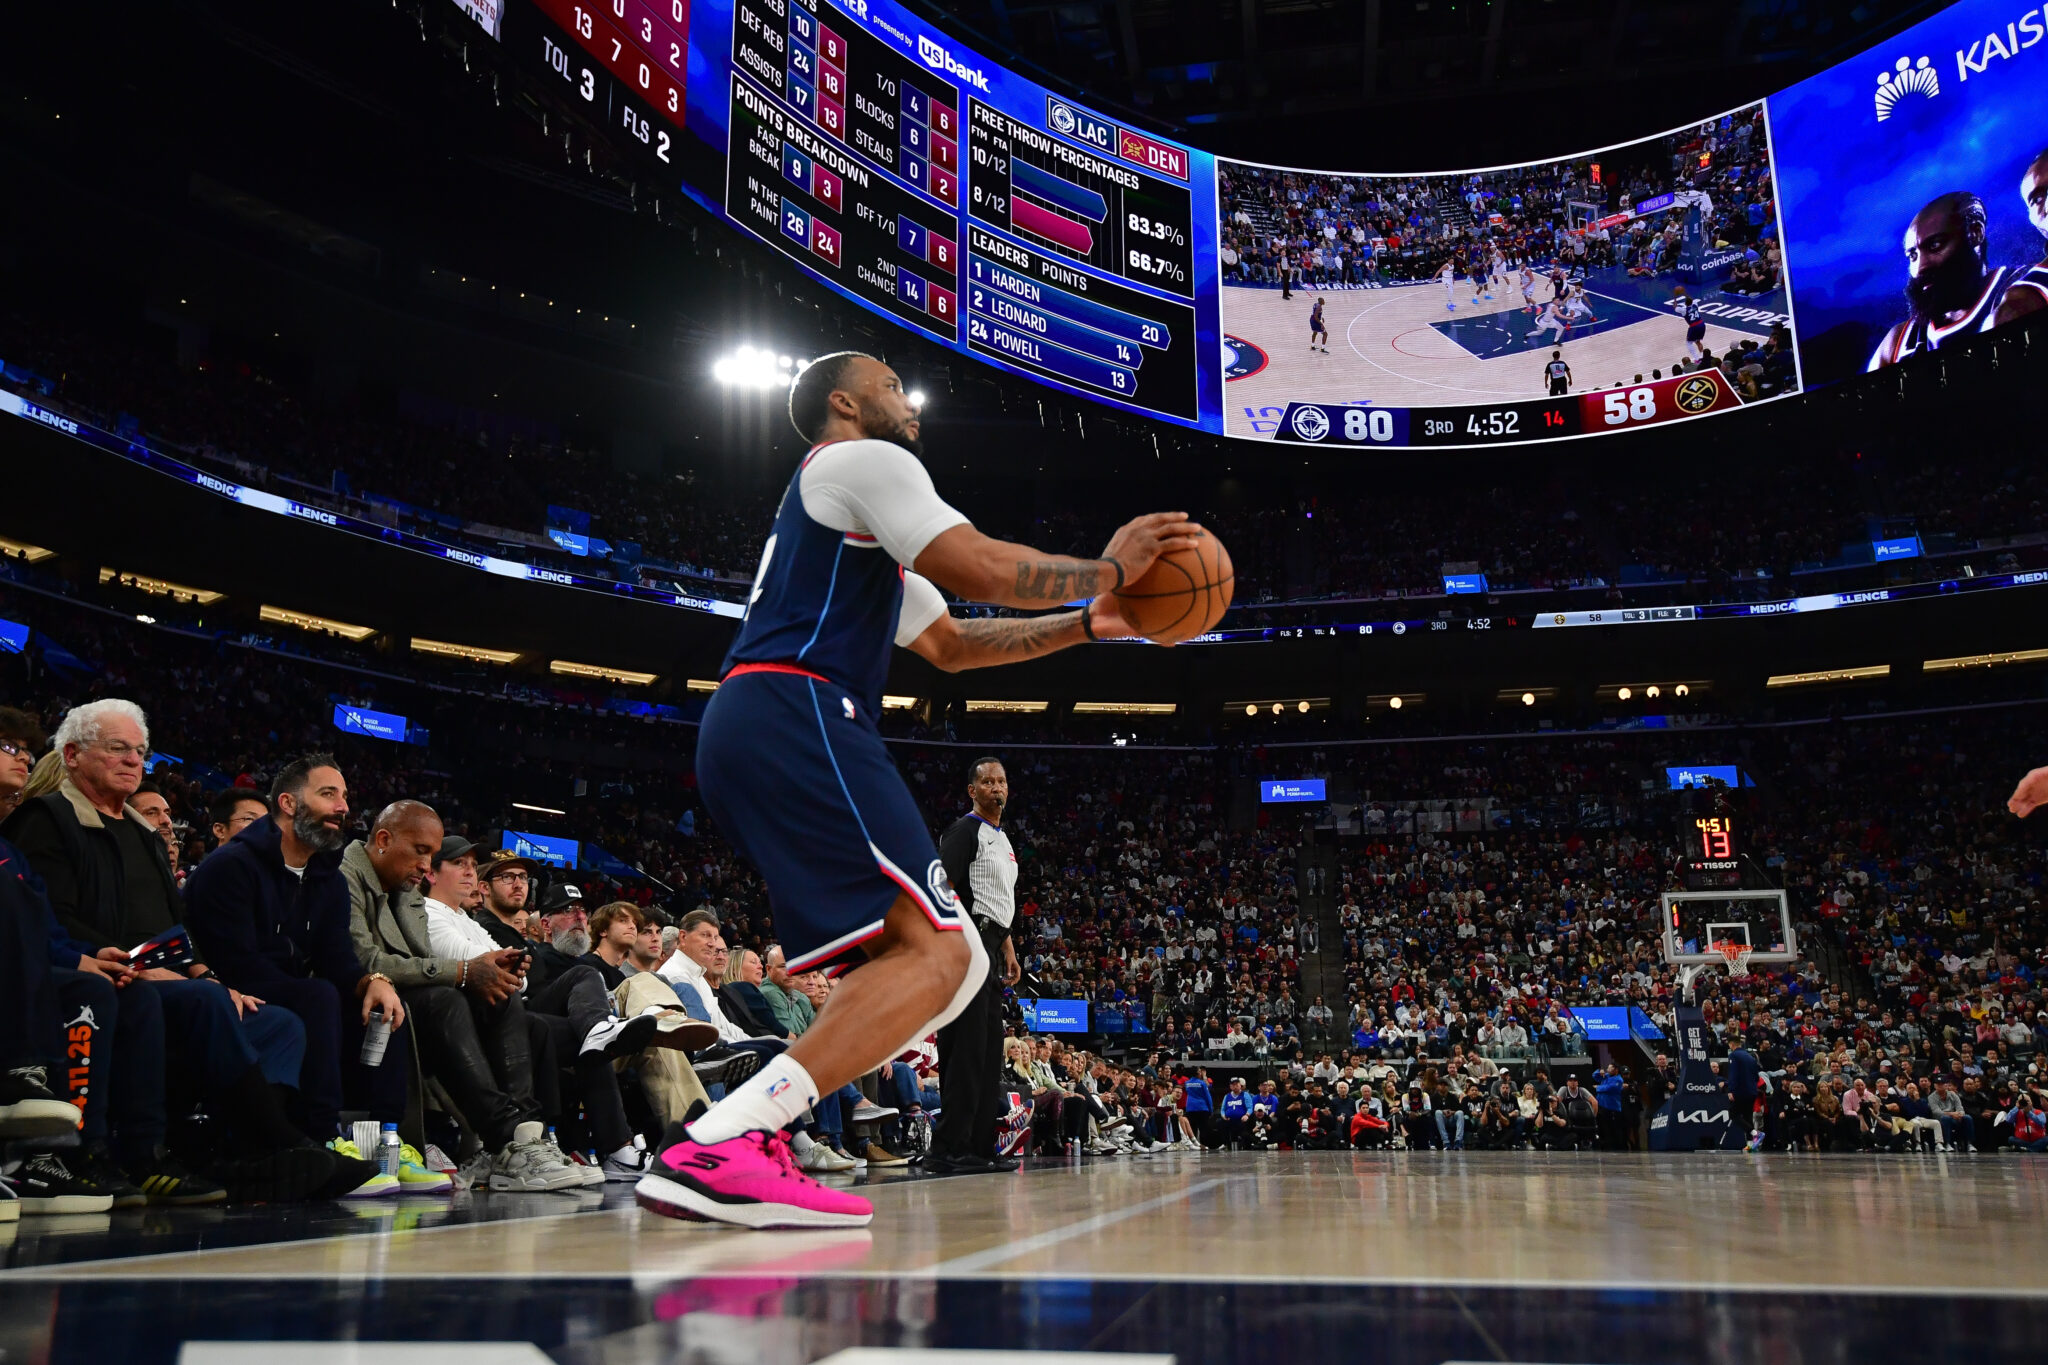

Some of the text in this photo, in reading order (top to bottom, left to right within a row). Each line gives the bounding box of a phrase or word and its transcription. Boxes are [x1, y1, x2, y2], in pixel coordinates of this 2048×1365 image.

[671, 0, 683, 23] 0
[795, 15, 810, 38] 10
[827, 39, 837, 58] 9
[873, 15, 904, 41] presented
[904, 34, 913, 48] by
[573, 6, 678, 113] 13 7 0 3
[640, 17, 652, 43] 3
[669, 42, 681, 68] 2
[741, 5, 839, 94] DEF REB 24 18
[1956, 2, 2048, 82] KAIS
[542, 35, 595, 102] TOL 3
[739, 43, 838, 129] ASSISTS 17 13
[876, 72, 949, 130] T/O 4 6
[622, 104, 671, 164] FLS 2
[736, 83, 868, 189] POINTS BREAKDOWN
[757, 124, 781, 151] FAST
[855, 93, 947, 162] BLOCKS 6 1
[971, 124, 1008, 151] FTM FTA
[974, 104, 1140, 190] FREE THROW PERCENTAGES
[1077, 117, 1107, 146] LAC
[749, 138, 832, 198] BREAK 9 3
[855, 128, 948, 196] STEALS 0 2
[1148, 145, 1179, 173] DEN
[748, 176, 779, 208] IN THE
[750, 197, 834, 255] PAINT 26 24
[856, 202, 947, 262] OFF T/O 7 6
[1128, 213, 1184, 246] 83.3%
[877, 257, 896, 277] 2ND
[973, 231, 1087, 291] LEADERS POINTS
[1129, 250, 1184, 282] 66.7%
[857, 265, 947, 314] CHANCE 14 6
[975, 262, 1159, 342] 1 HARDEN 20
[974, 290, 1131, 361] 2 LEONARD 14
[970, 319, 1125, 389] 24 POWELL 13
[1343, 388, 1657, 442] 80 3RD 4:52 14 58
[1296, 629, 1303, 638] 2
[1329, 627, 1336, 636] 4
[1359, 625, 1373, 634] 80
[1431, 621, 1447, 631] 3RD
[1467, 618, 1491, 630] 4:52
[1589, 613, 1602, 622] 58
[1638, 610, 1645, 619] 3
[1675, 609, 1682, 618] 2
[1696, 818, 1731, 832] 4:51
[1702, 831, 1731, 859] 13
[1702, 861, 1738, 870] TISSOT
[1687, 1027, 1700, 1038] GET
[1689, 1038, 1702, 1048] THE
[1686, 1082, 1716, 1093] Google
